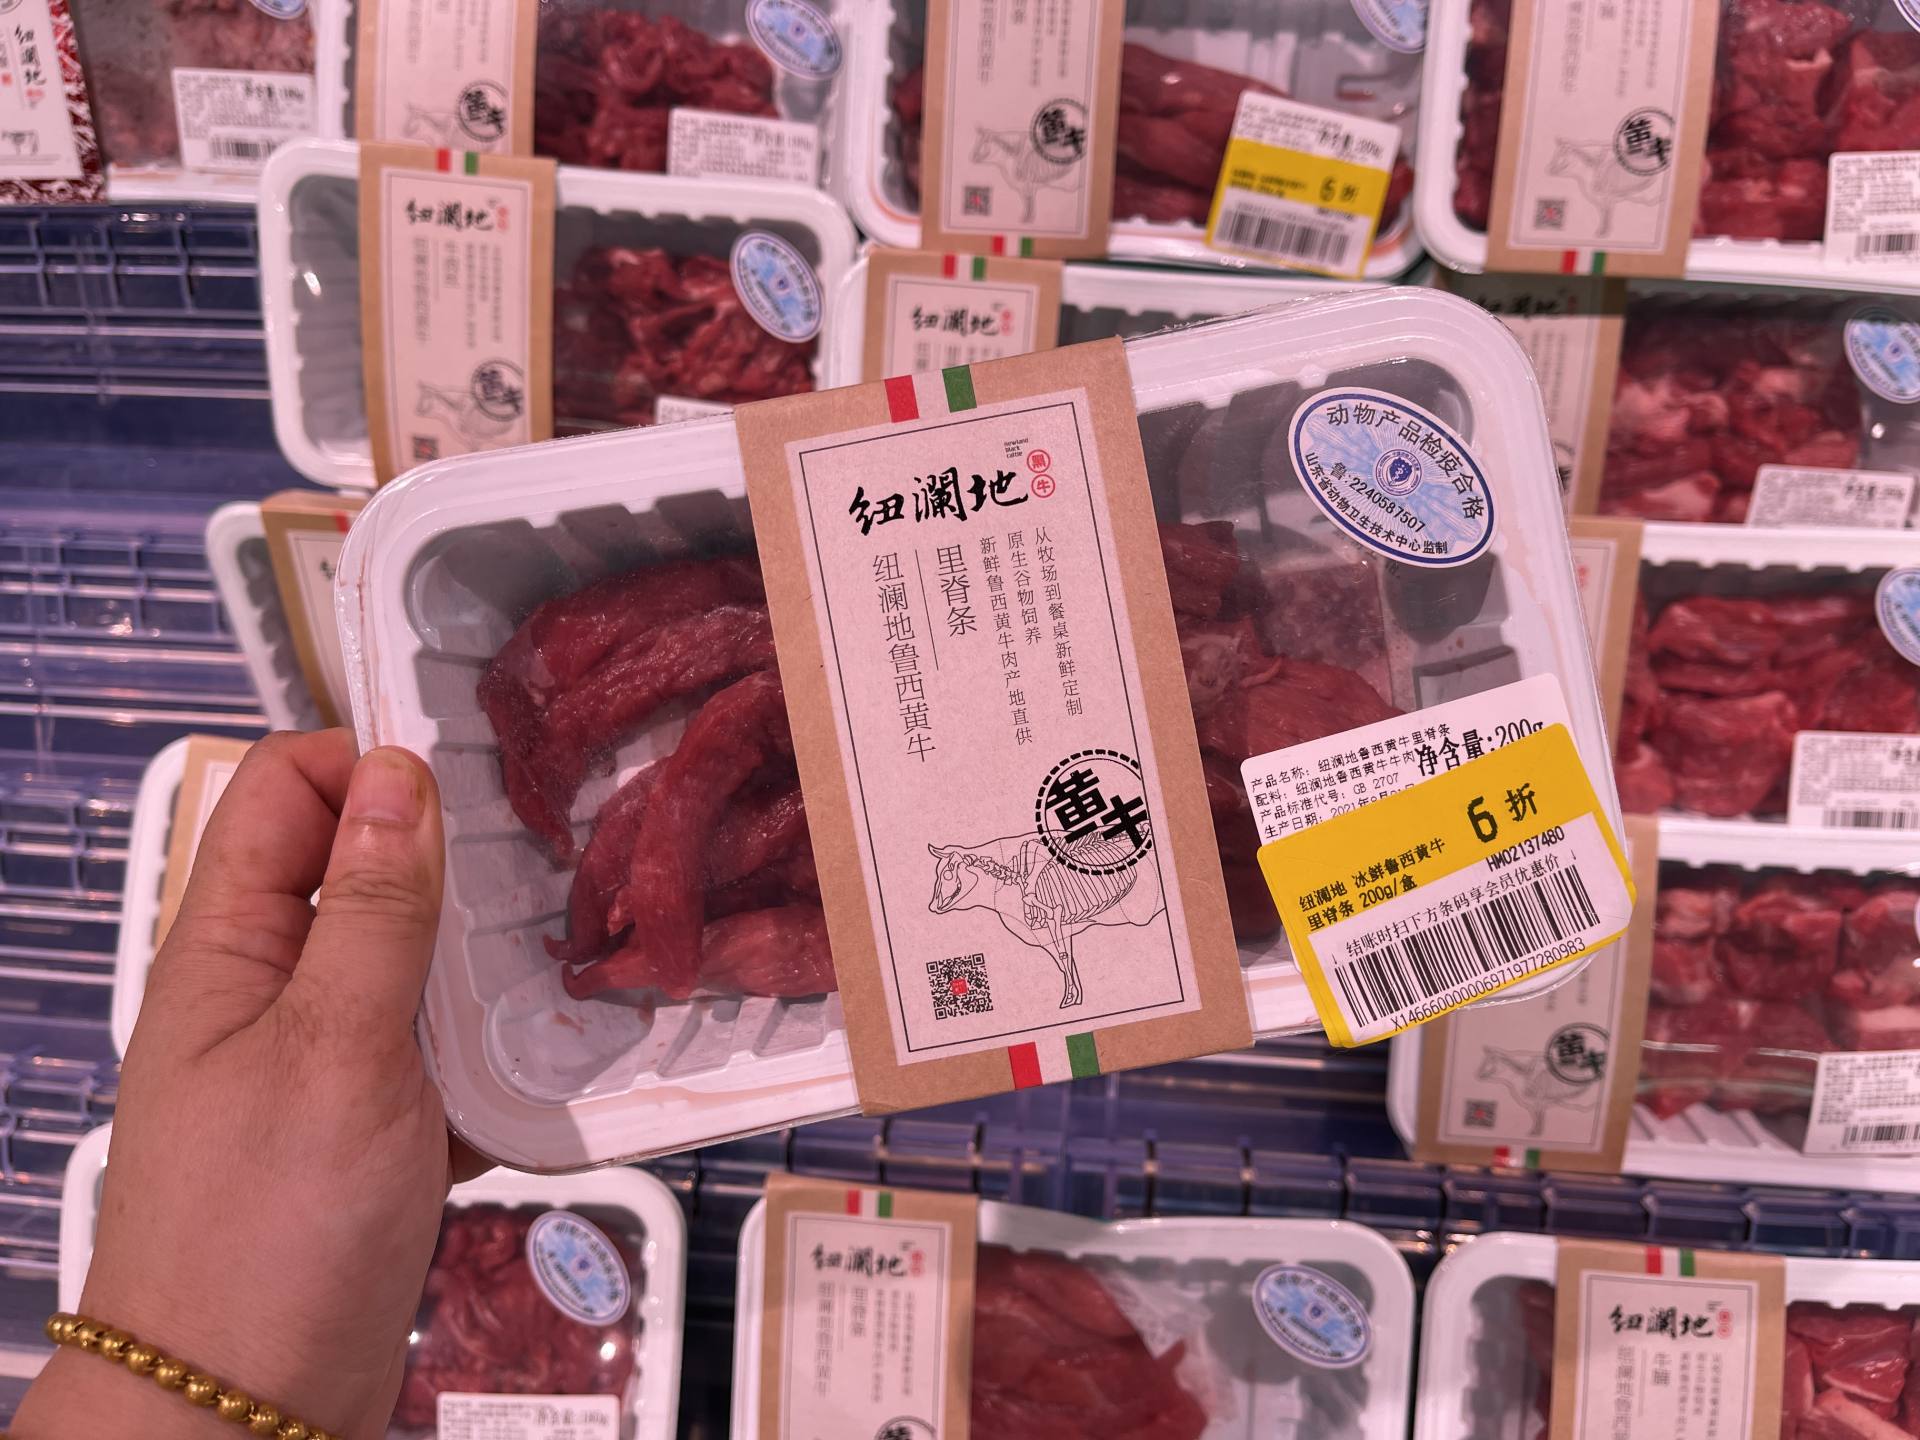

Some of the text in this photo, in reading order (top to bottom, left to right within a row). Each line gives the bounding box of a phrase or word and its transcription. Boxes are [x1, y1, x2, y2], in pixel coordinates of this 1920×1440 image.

[849, 466, 1028, 536] 纽澜地
[1304, 451, 1448, 555] 山东省动物卫生技术中心监制
[1326, 402, 1485, 520] 动物产品检疫合格
[936, 542, 979, 638] 里脊条
[1006, 530, 1042, 646] 原生谷物饲养
[1034, 525, 1084, 717] 从牧场到餐桌新鲜定制
[872, 551, 937, 762] 纽澜地鲁西黄牛
[978, 535, 1034, 746] 新鲜鲁西黄牛肉产地直供
[1295, 751, 1415, 796] 纽澜地鲁西黄牛牛肉
[1317, 722, 1451, 773] 纽澜地鲁西黄牛里脊条
[1352, 782, 1367, 795] GB
[1372, 772, 1399, 789] 2707
[1045, 768, 1149, 850] 黄牛
[1466, 781, 1537, 843] 6 折
[1486, 825, 1565, 872] HM02137480
[1298, 836, 1446, 913] 纽澜地 冰鲜鲁西黄牛
[1307, 873, 1418, 932] 里脊条 200g/盒
[1345, 853, 1561, 958] 结账时扫下方条码享会员优惠价
[1391, 936, 1586, 1032] X146660000006971977280983
